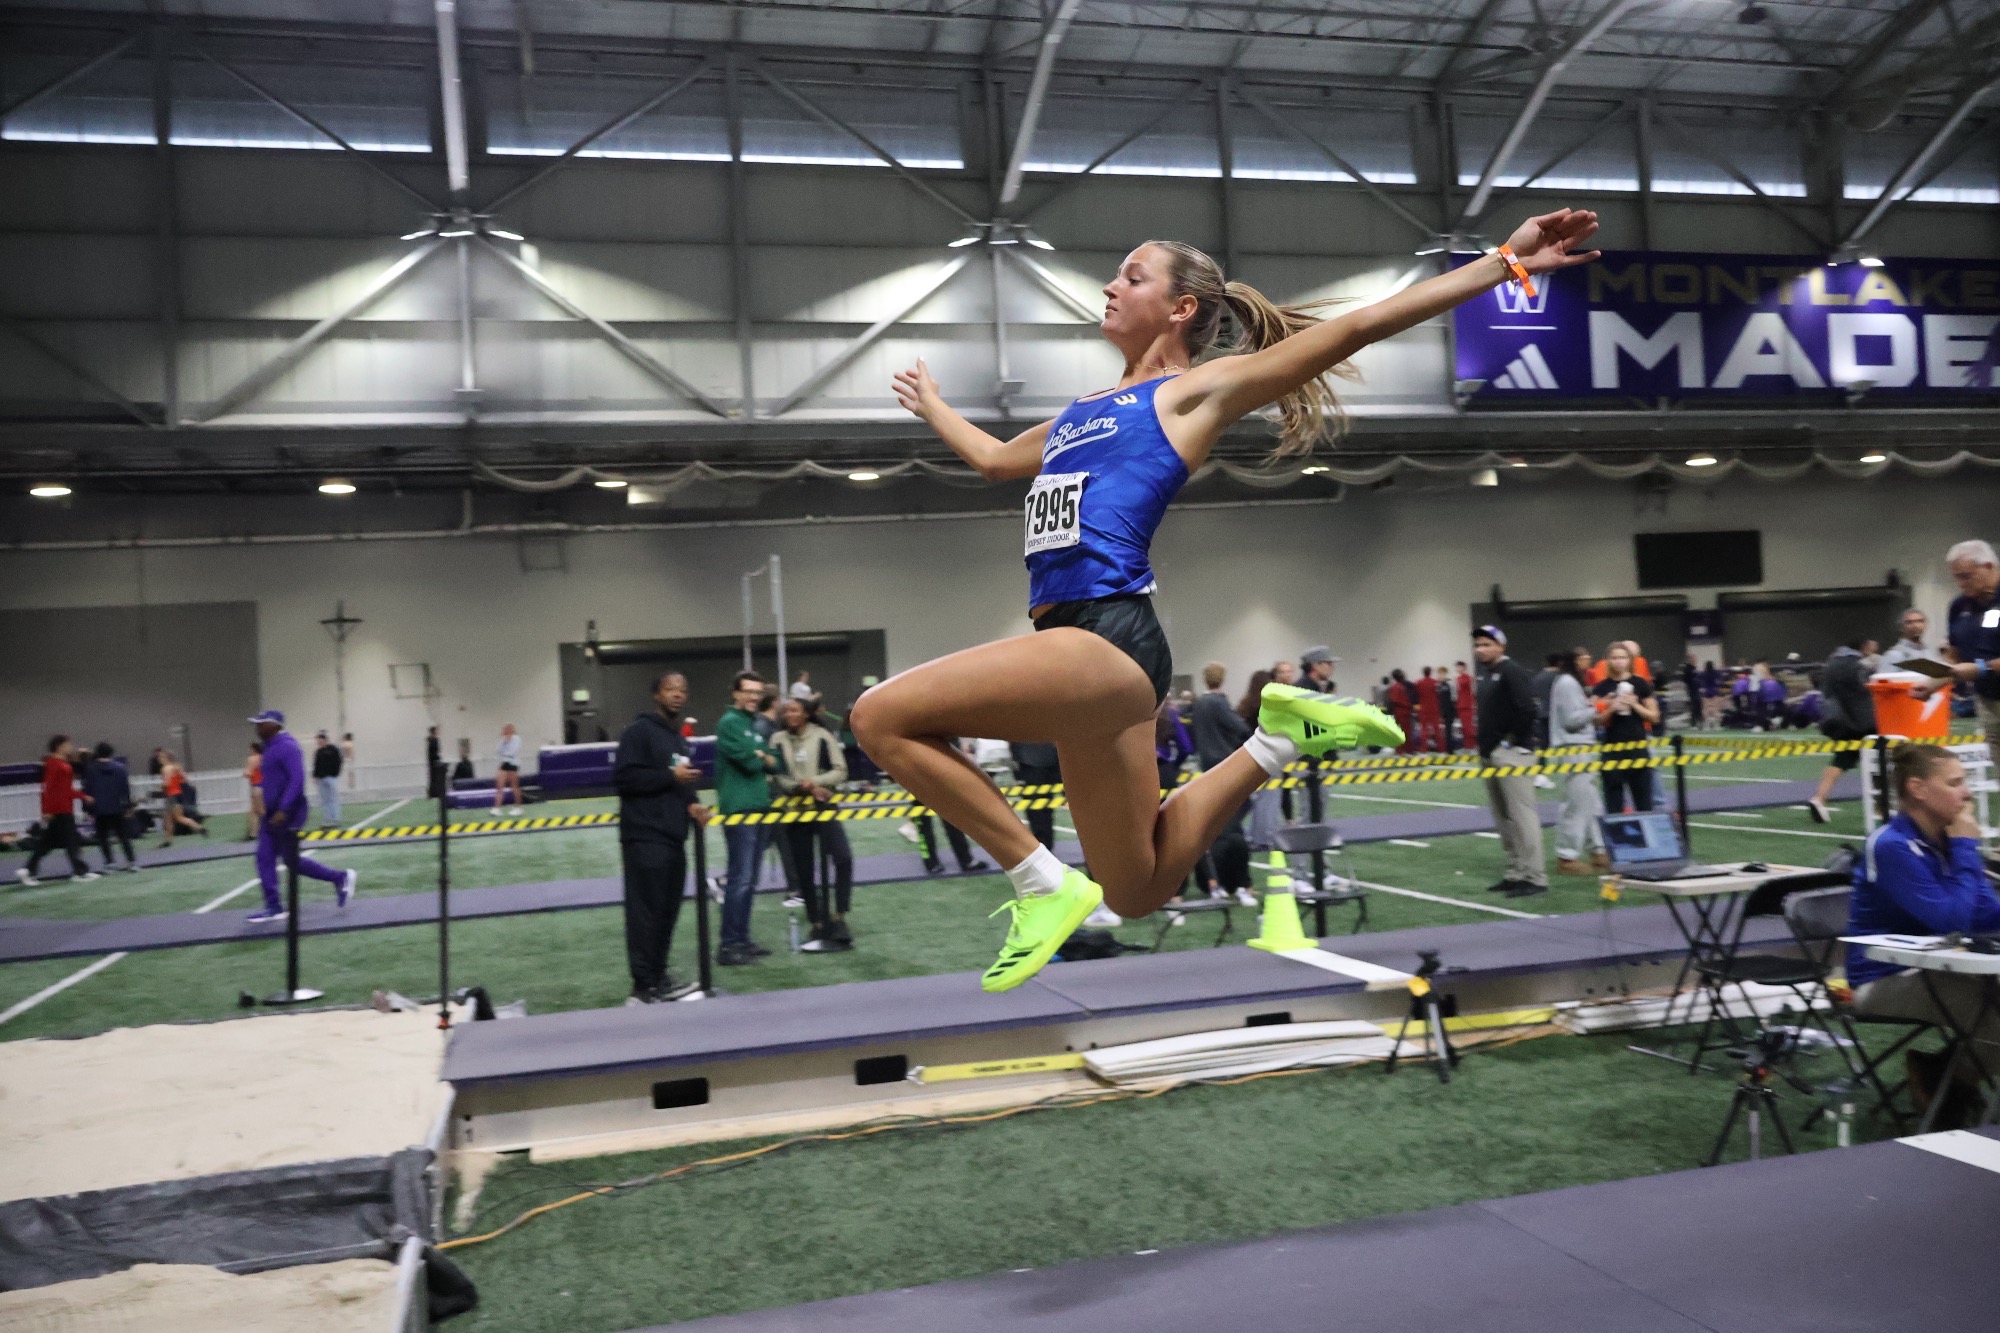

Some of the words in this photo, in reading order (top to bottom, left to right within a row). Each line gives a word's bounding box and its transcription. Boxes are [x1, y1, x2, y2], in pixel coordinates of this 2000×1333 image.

[1587, 262, 2000, 307] MONTLAKE
[1588, 310, 2000, 389] MADE
[1057, 416, 1118, 448] Barbara
[1026, 484, 1079, 539] 7995
